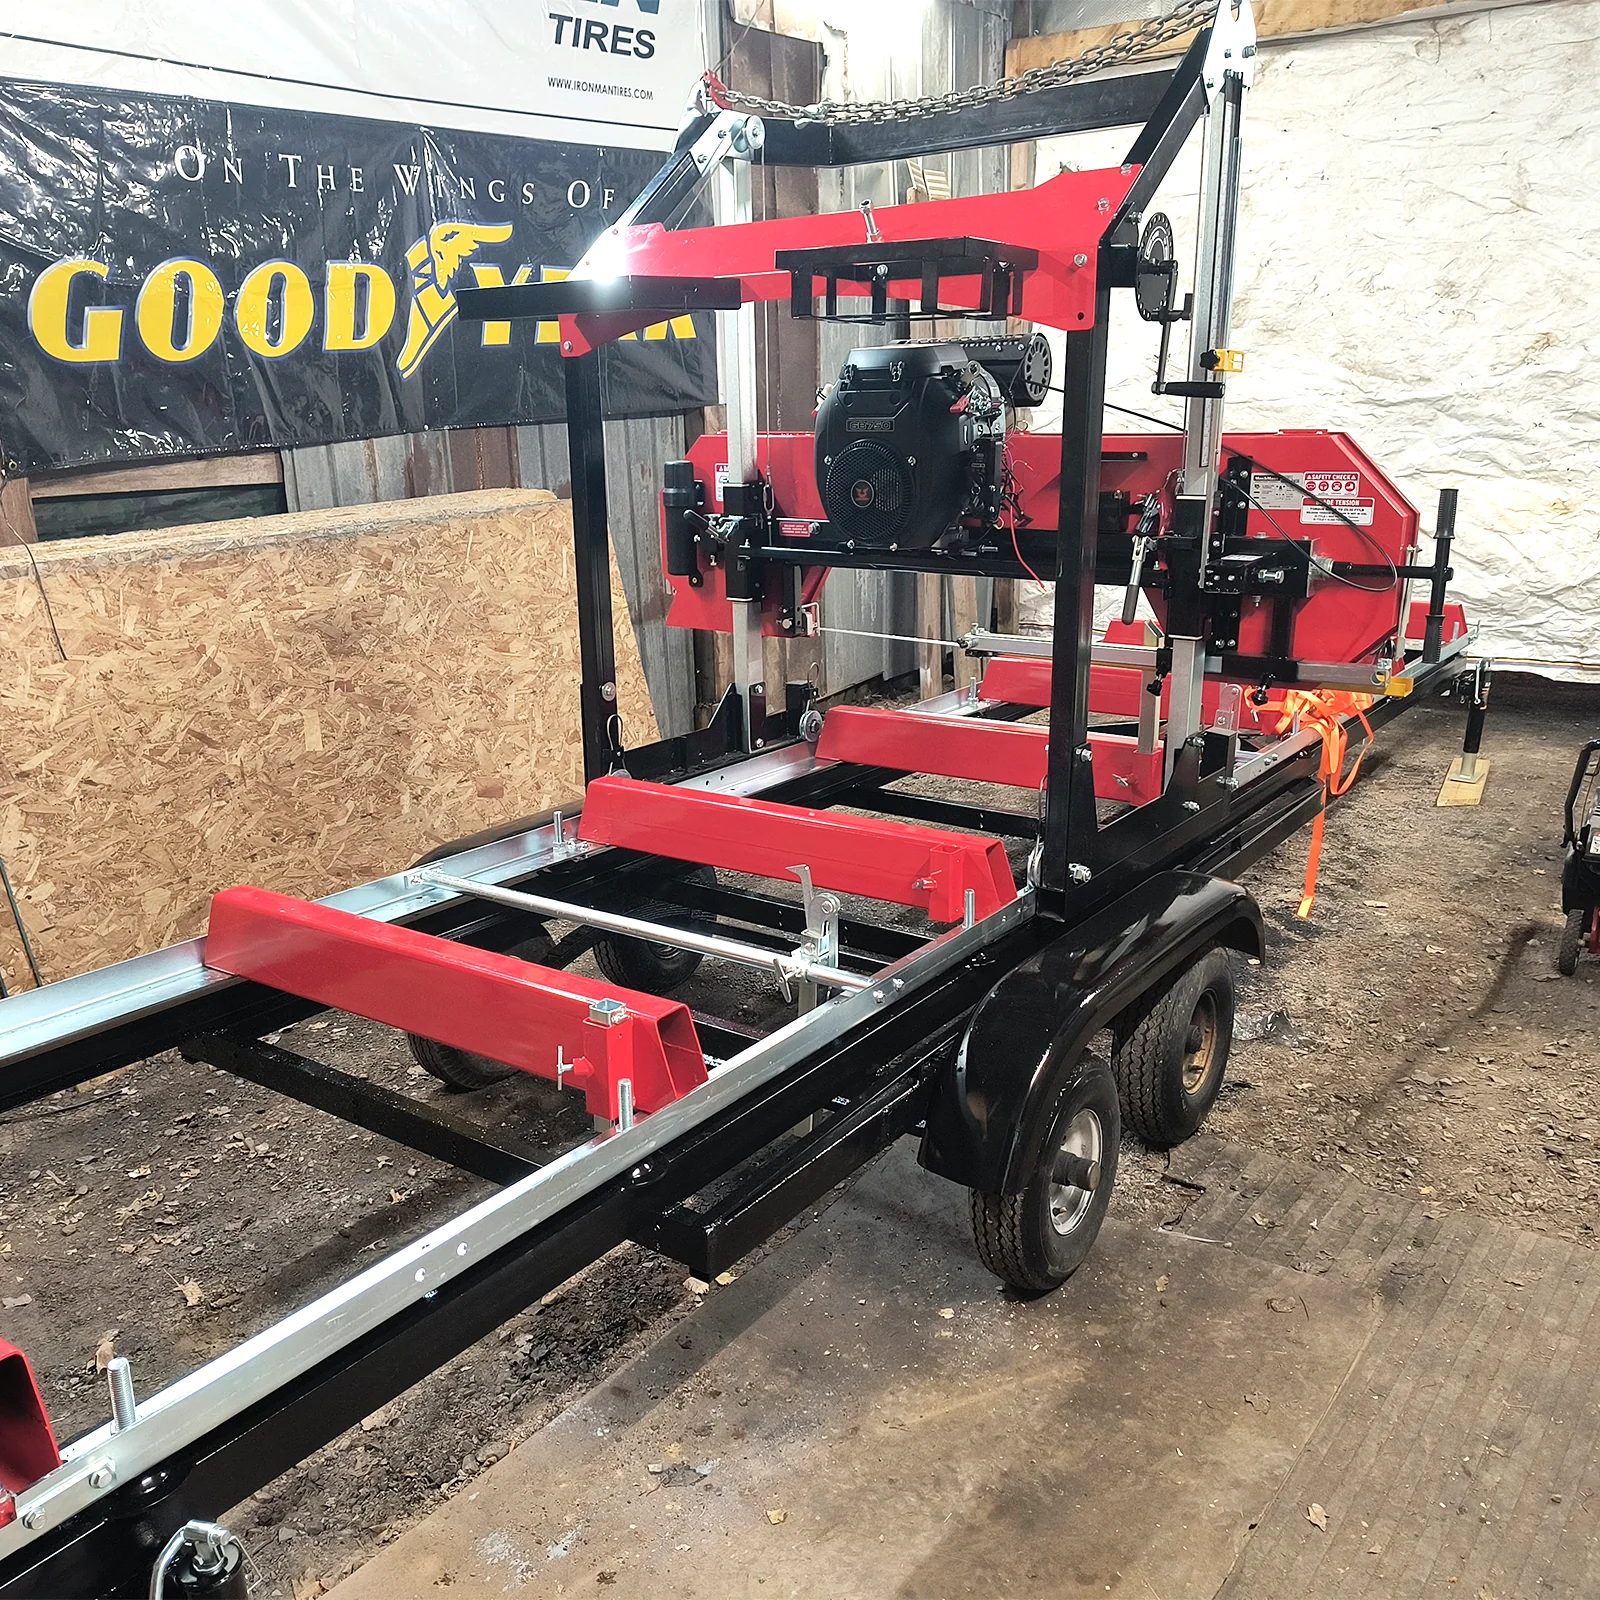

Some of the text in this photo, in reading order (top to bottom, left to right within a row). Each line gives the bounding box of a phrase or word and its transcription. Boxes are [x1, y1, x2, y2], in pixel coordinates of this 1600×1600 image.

[549, 13, 656, 59] TIRES
[547, 76, 654, 101] WWW.IRONMANTIRES.COM
[174, 145, 615, 210] ON THE WINGS OF
